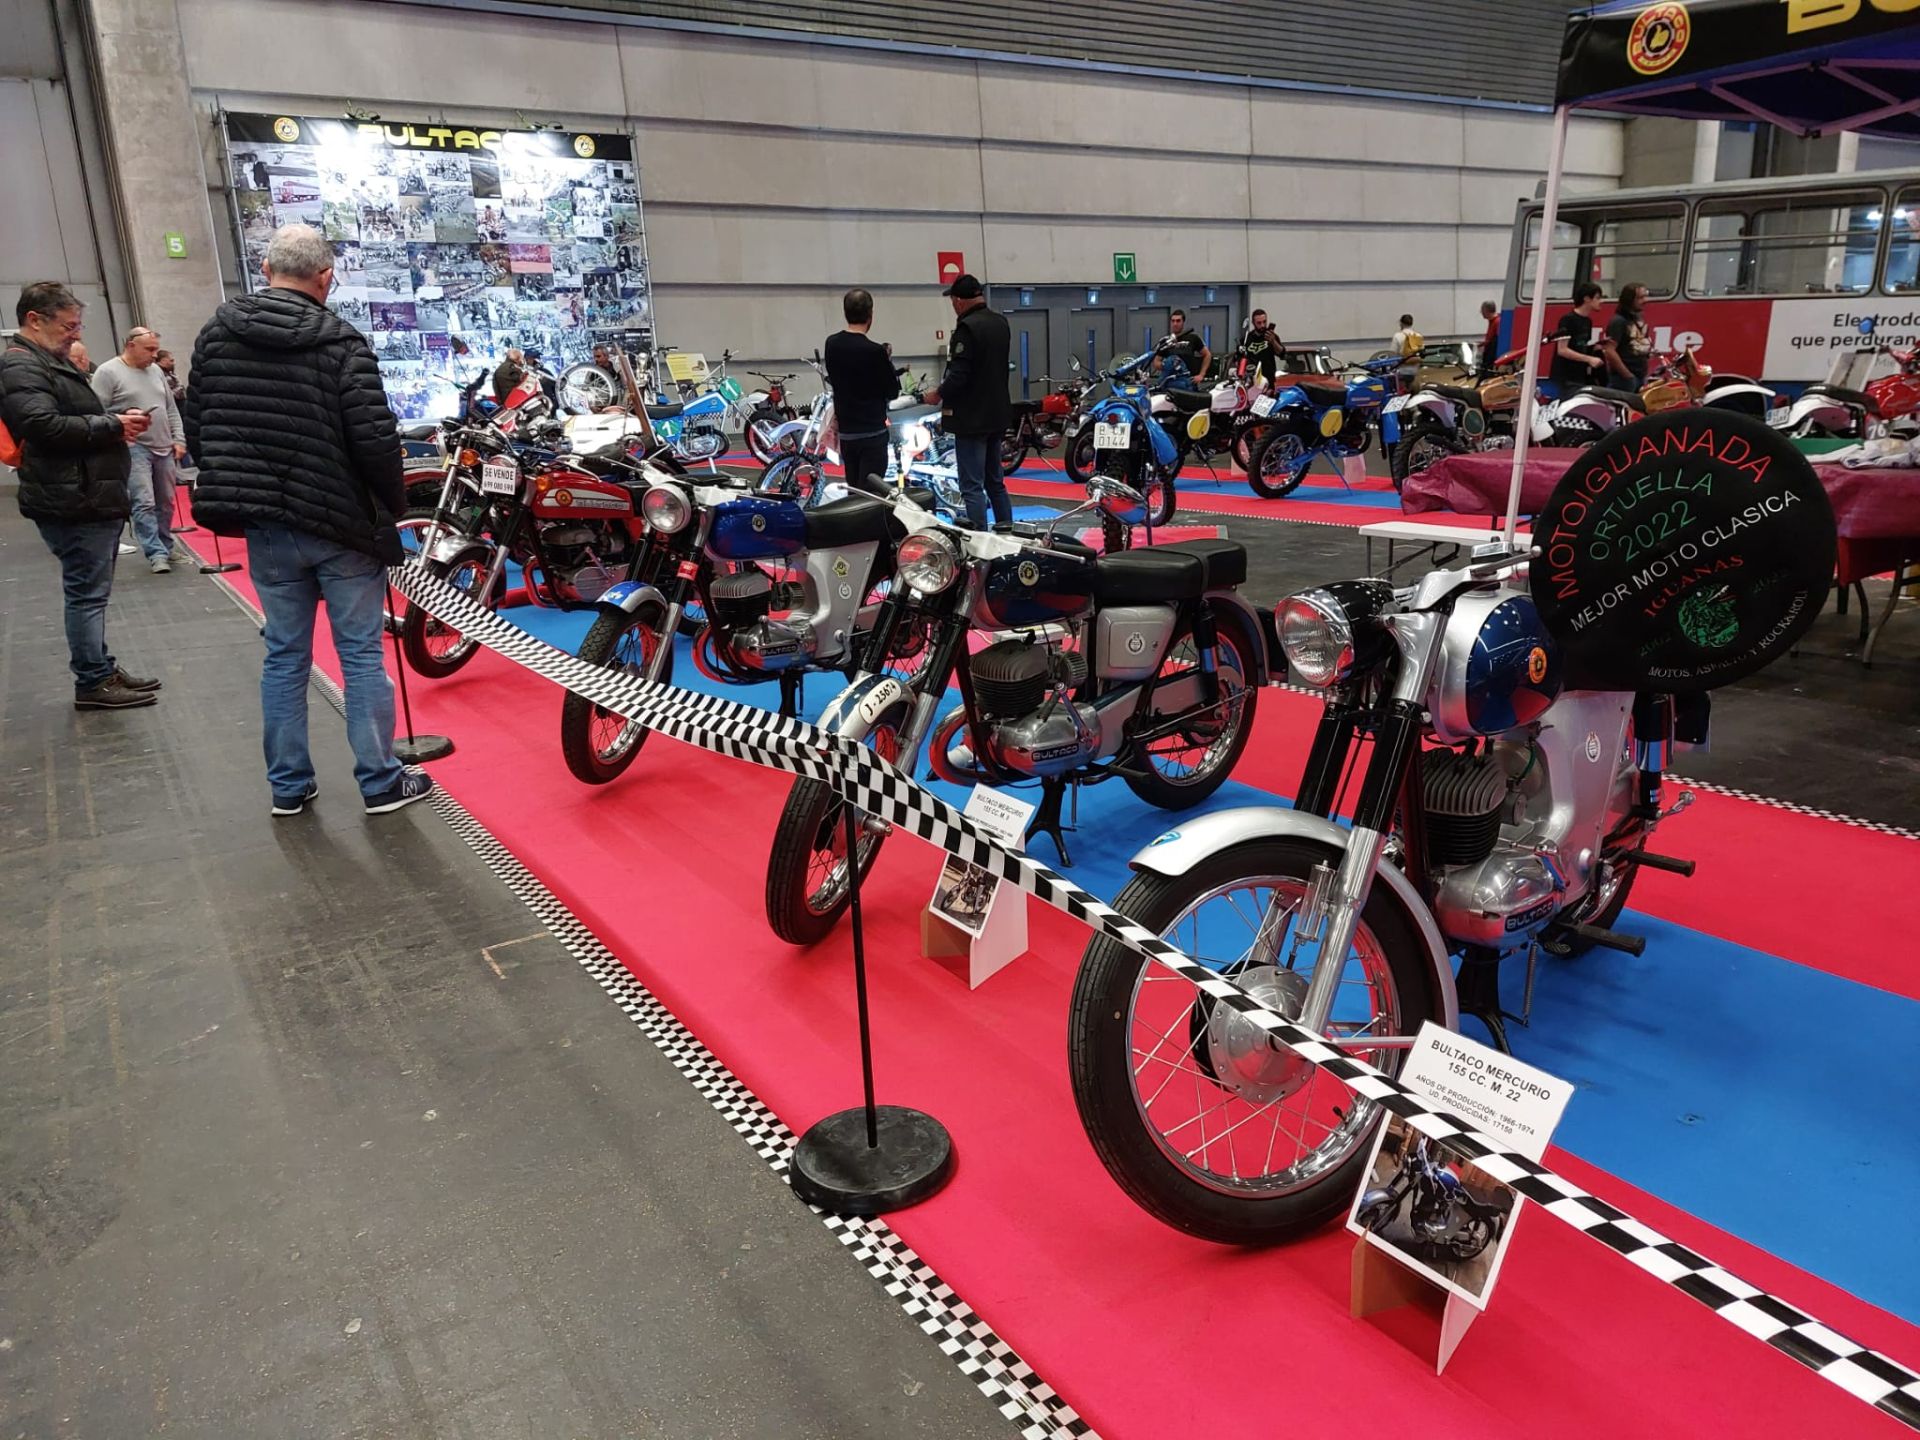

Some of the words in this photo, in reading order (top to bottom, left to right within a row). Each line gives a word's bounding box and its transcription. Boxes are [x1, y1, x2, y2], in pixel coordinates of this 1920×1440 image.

[170, 237, 183, 253] 5
[1791, 335, 1825, 349] que
[724, 380, 738, 397] 1
[662, 420, 675, 437] 1
[1098, 436, 1126, 447] 0144
[1867, 424, 1887, 440] 76
[484, 467, 492, 477] SE
[493, 468, 513, 480] VENDE
[1549, 426, 1772, 600] MOTOIGUANADA
[1589, 468, 1713, 560] ORTUELLA
[1618, 500, 1698, 562] 2022
[1570, 583, 1632, 632] MEJOR
[1632, 543, 1698, 591] MOTO
[1701, 490, 1800, 548] CLASICA
[1644, 555, 1744, 618] IGUANAS
[864, 702, 873, 717] J
[1033, 745, 1078, 760] BULTACO
[1507, 901, 1553, 929] BULTACO
[1431, 1039, 1484, 1070] BULTACO
[1485, 1064, 1551, 1101] MERCURIO
[1448, 1061, 1467, 1077] 155
[1468, 1070, 1487, 1088] CC.
[1490, 1081, 1503, 1095] M.
[1505, 1088, 1521, 1102] 22
[1415, 1073, 1436, 1088] AÑOS
[1436, 1083, 1446, 1093] DE
[1447, 1088, 1498, 1117] PRODUCCIÓN:
[1428, 1088, 1441, 1100] UD.
[1441, 1095, 1491, 1124] PRODUCIDAS:
[1492, 1119, 1513, 1135] 17150
